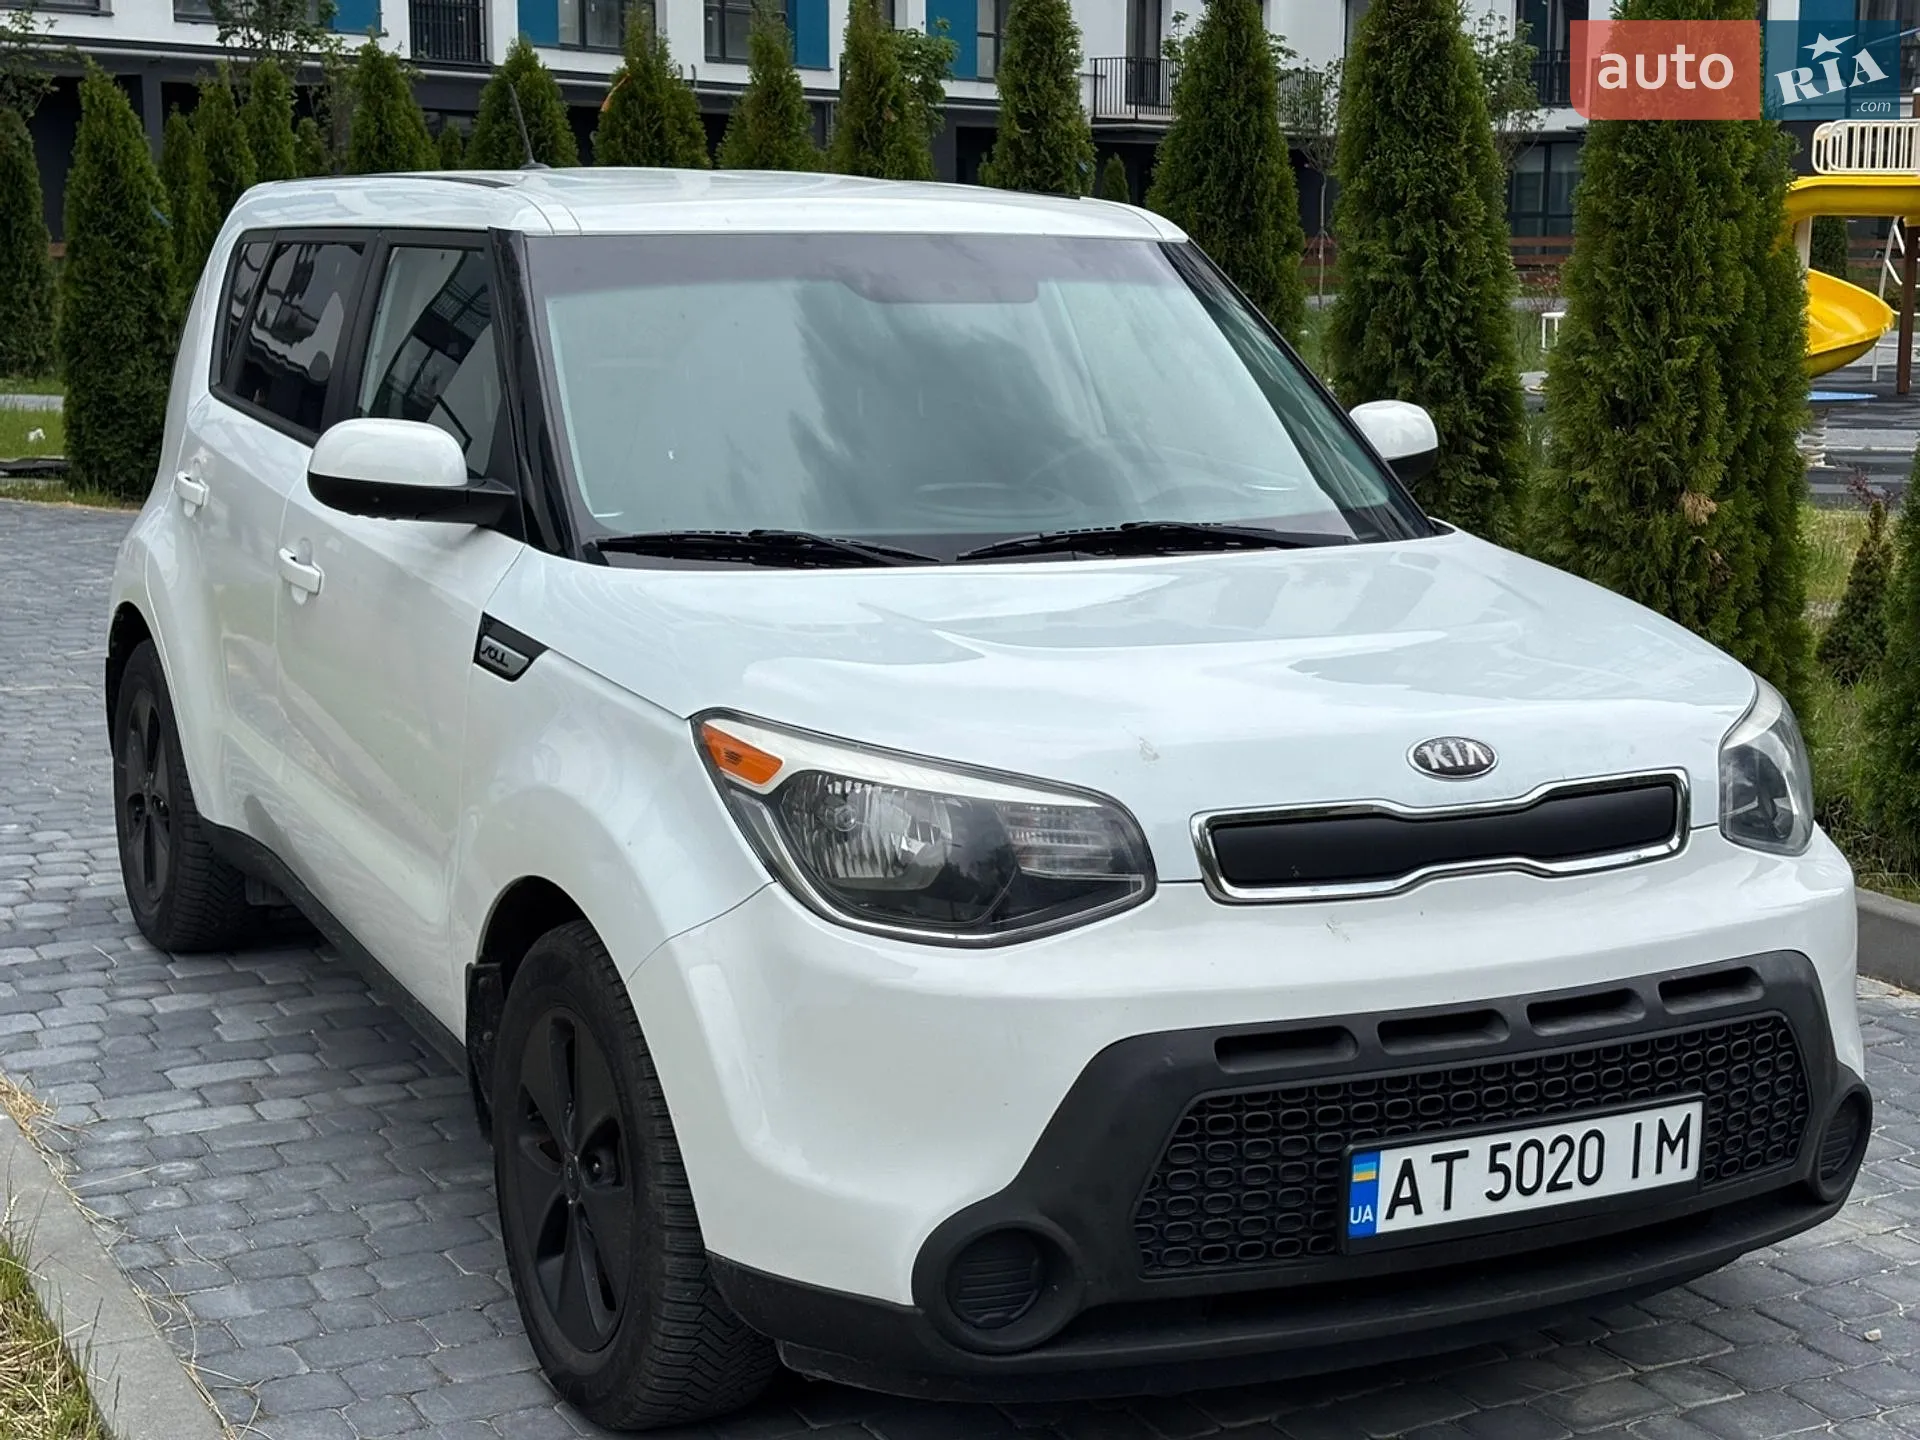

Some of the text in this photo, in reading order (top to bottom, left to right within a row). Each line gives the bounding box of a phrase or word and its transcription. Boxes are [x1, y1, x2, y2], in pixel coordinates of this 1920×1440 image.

[1420, 740, 1490, 769] KIA
[1385, 1112, 1692, 1220] AT 5020 IM
[1349, 1206, 1374, 1225] UA
